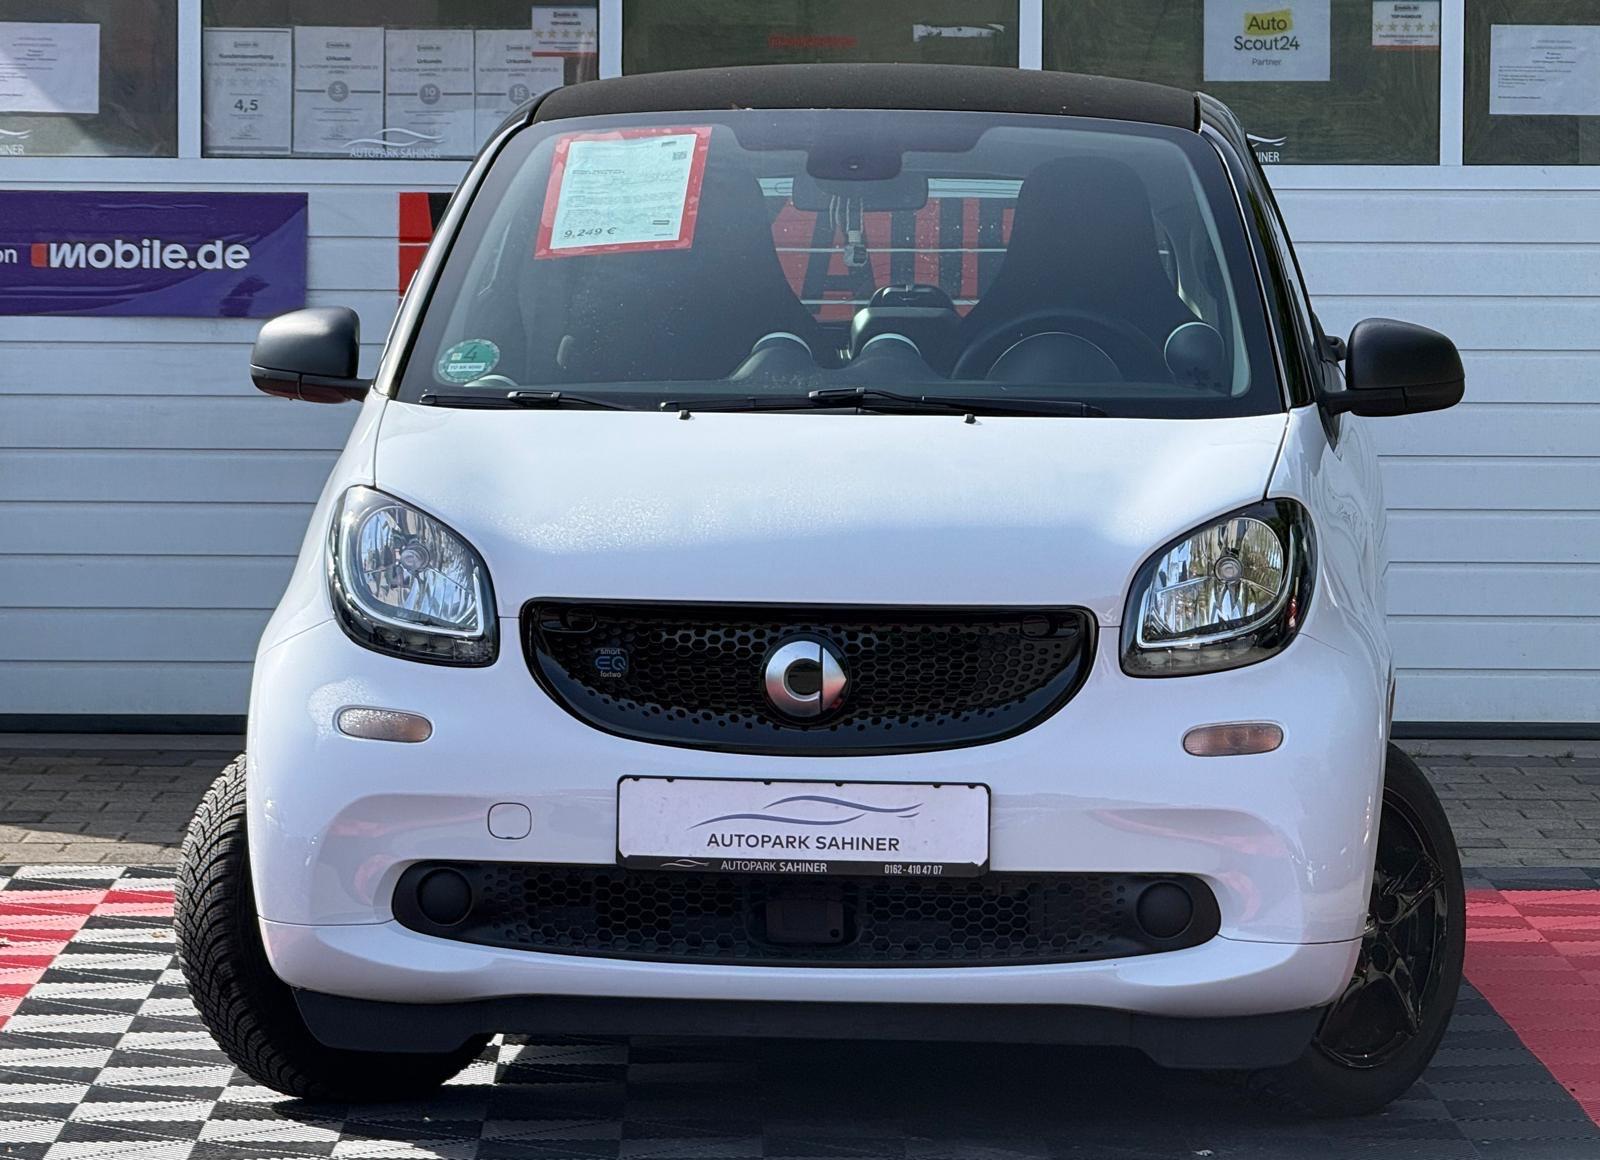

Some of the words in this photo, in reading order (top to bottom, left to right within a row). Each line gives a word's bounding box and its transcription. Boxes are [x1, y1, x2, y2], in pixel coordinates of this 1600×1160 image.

[1247, 16, 1288, 31] Auto
[1233, 35, 1300, 51] Scout24
[1251, 58, 1282, 66] Partner
[424, 87, 436, 97] 10
[233, 98, 259, 113] 4,5
[350, 147, 398, 158] AUTOPARK
[400, 147, 440, 158] SAHINER
[50, 238, 250, 270] mobile.de
[463, 344, 478, 361] 4
[595, 655, 626, 671] EQ
[707, 833, 811, 850] AUTOPARK
[815, 835, 901, 852] SAHINER
[720, 860, 777, 872] AUTOPARK
[779, 861, 828, 873] SAHINER
[922, 865, 933, 875] 47
[933, 865, 943, 875] 07
